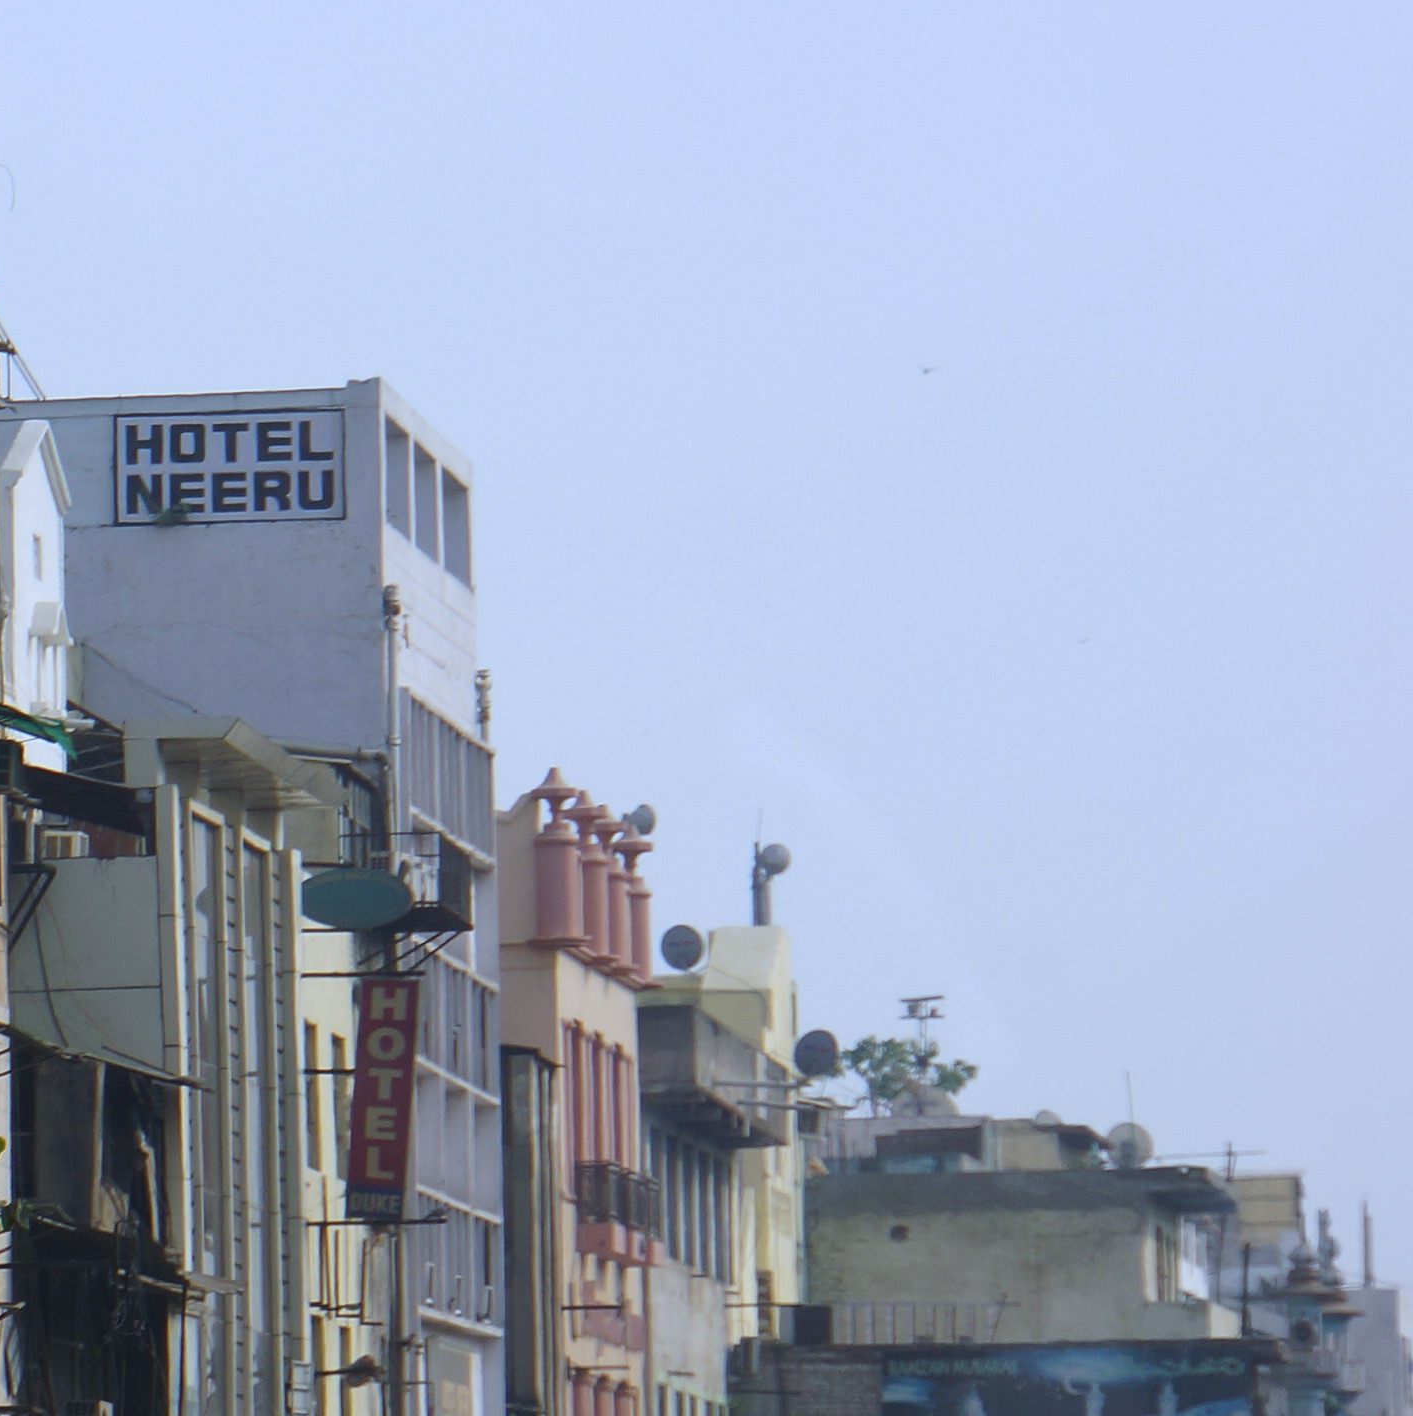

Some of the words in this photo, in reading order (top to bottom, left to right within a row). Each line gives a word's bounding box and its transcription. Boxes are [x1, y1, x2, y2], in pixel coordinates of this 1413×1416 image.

[125, 421, 334, 465] HOTEL
[125, 470, 334, 515] NEERU
[363, 986, 410, 1180] HOTEL
